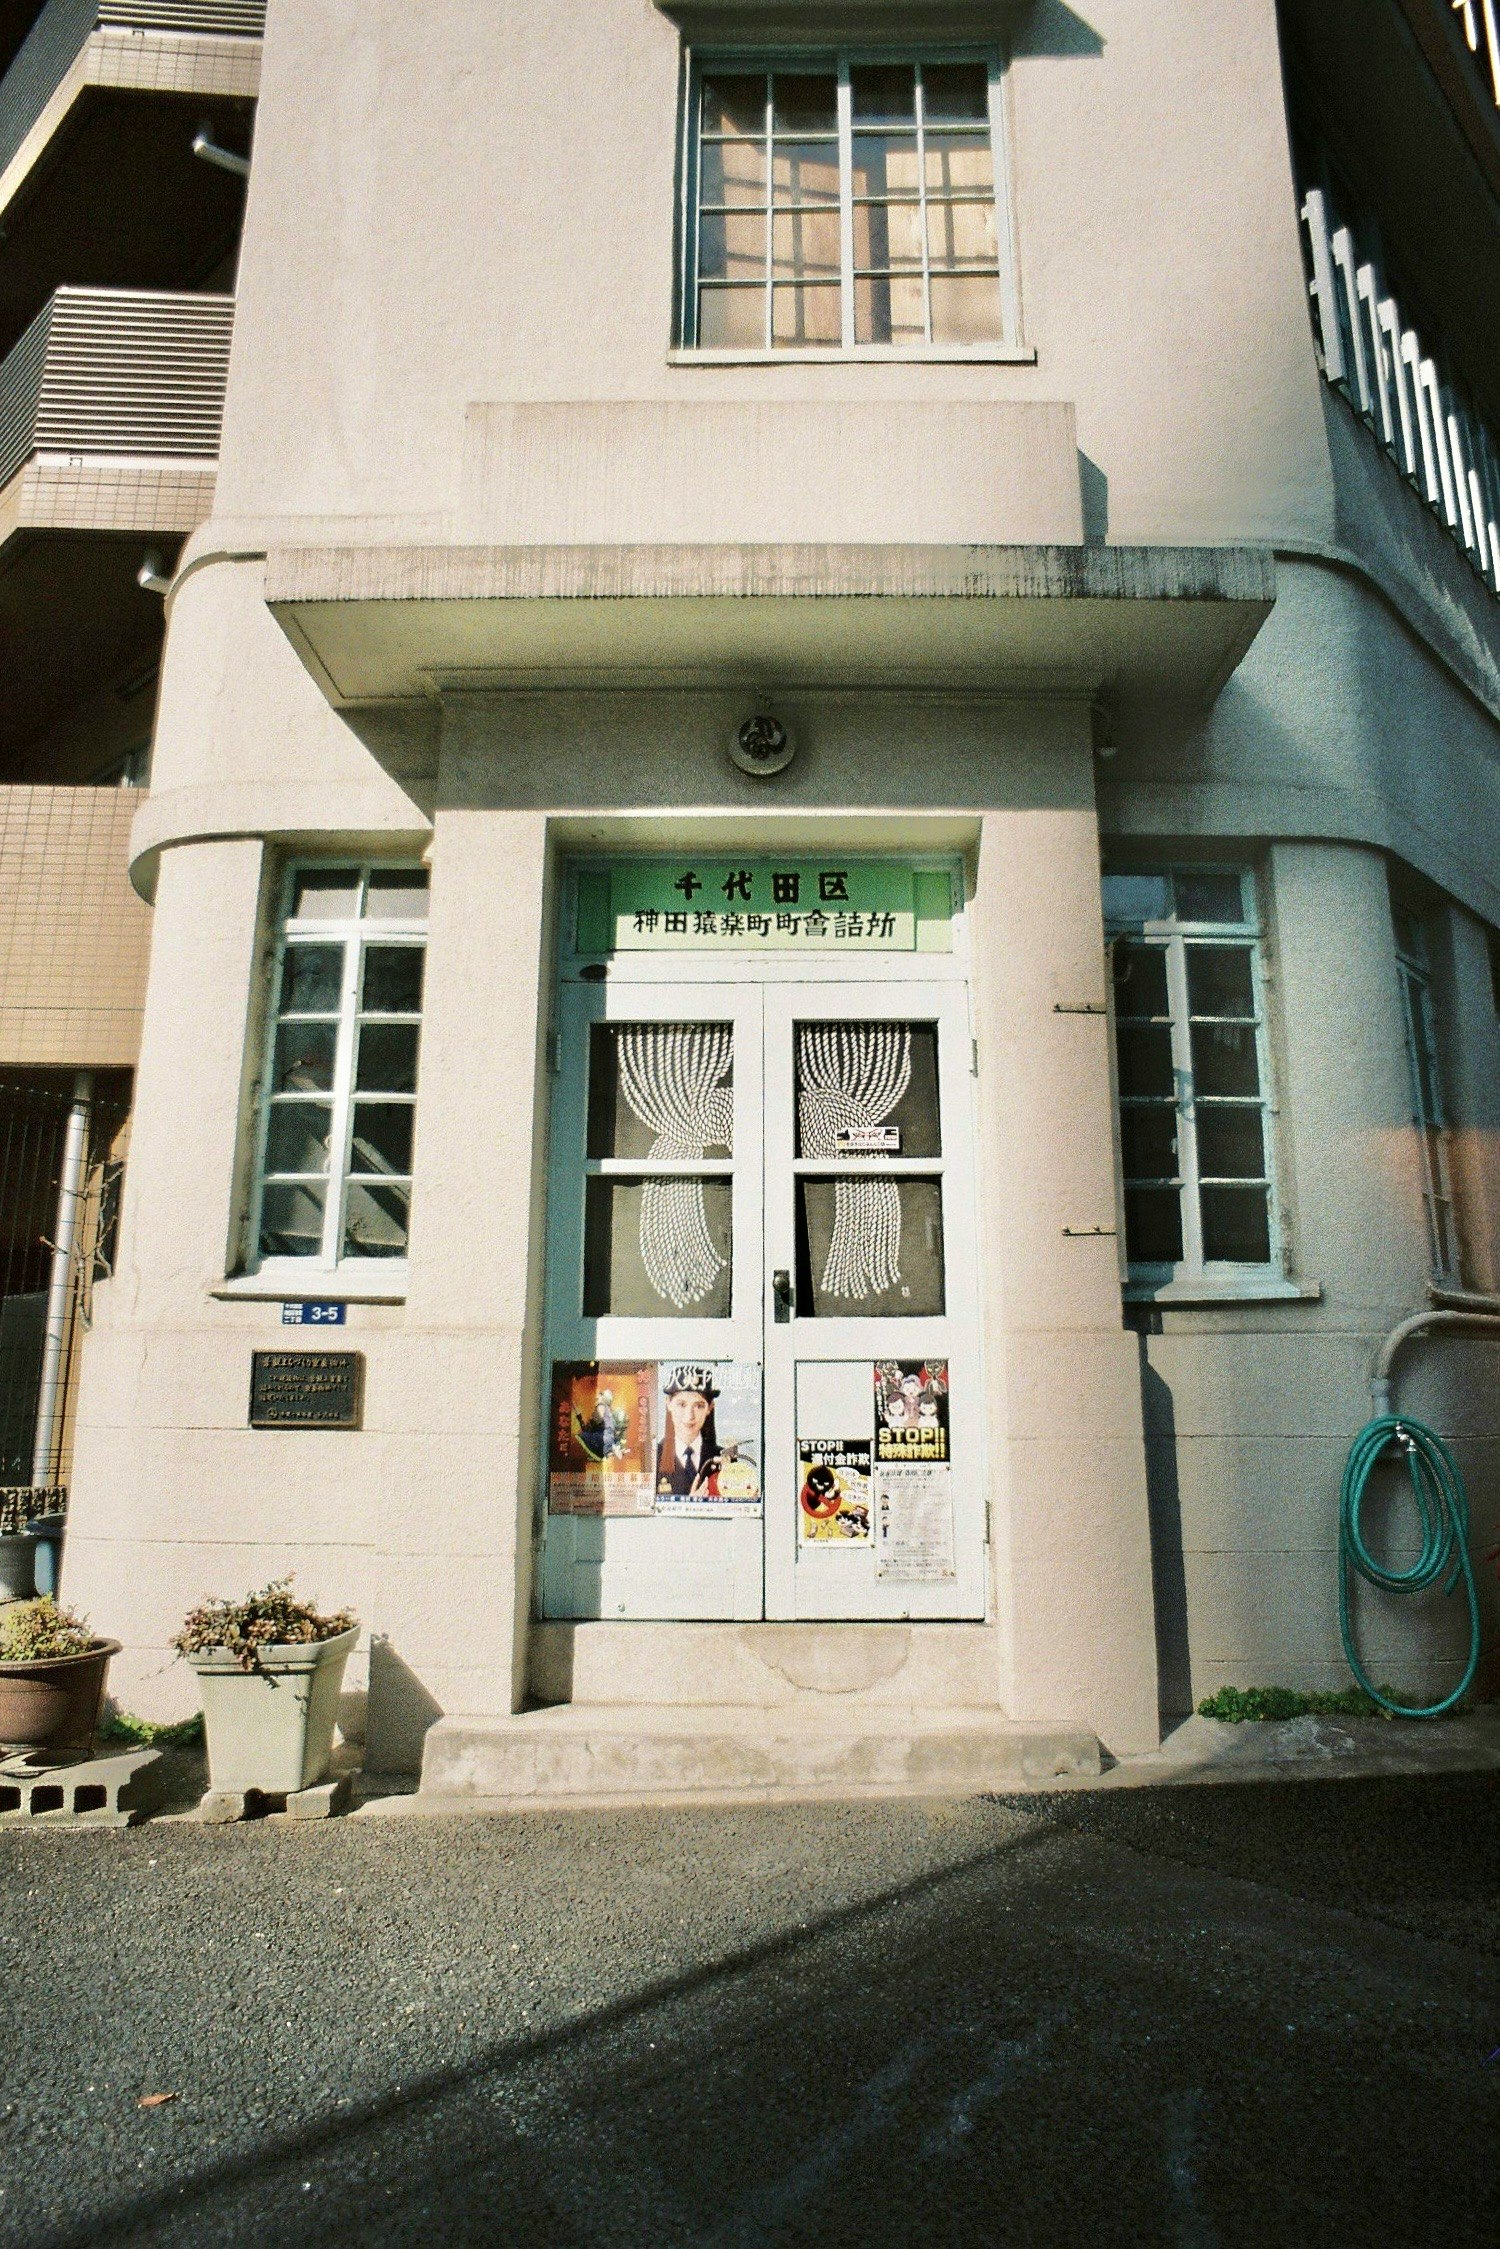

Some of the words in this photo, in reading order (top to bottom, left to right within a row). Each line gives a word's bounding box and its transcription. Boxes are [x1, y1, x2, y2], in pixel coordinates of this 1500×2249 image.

[674, 870, 849, 903] 千代田区
[633, 908, 896, 938] 神田猿楽町町會詰所
[311, 1306, 339, 1321] 3-5
[811, 1452, 871, 1466] 還付金詐欺
